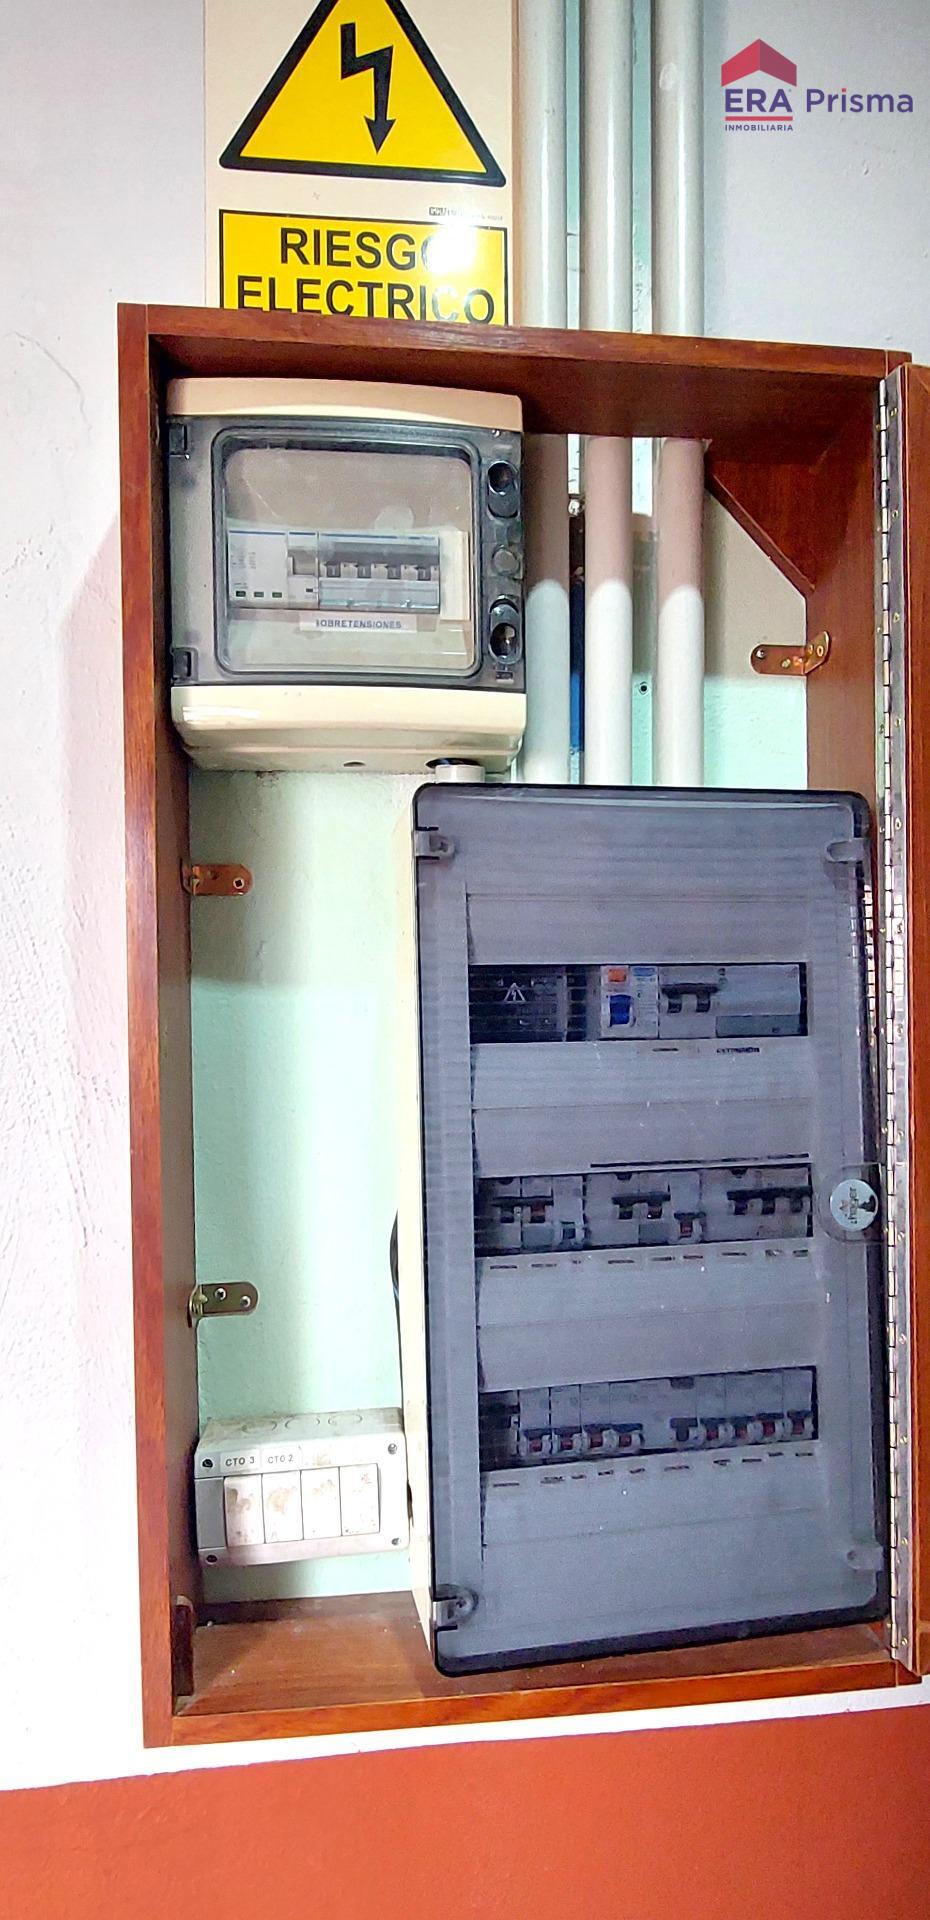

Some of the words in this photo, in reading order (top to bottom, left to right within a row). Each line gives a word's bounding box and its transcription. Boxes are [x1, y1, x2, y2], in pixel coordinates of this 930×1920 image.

[280, 226, 453, 272] RIESG
[237, 275, 495, 324] ELECTRICO
[225, 1457, 246, 1467] CTO
[249, 1456, 255, 1464] 3
[267, 1455, 287, 1464] CTO
[288, 1454, 294, 1462] 2
